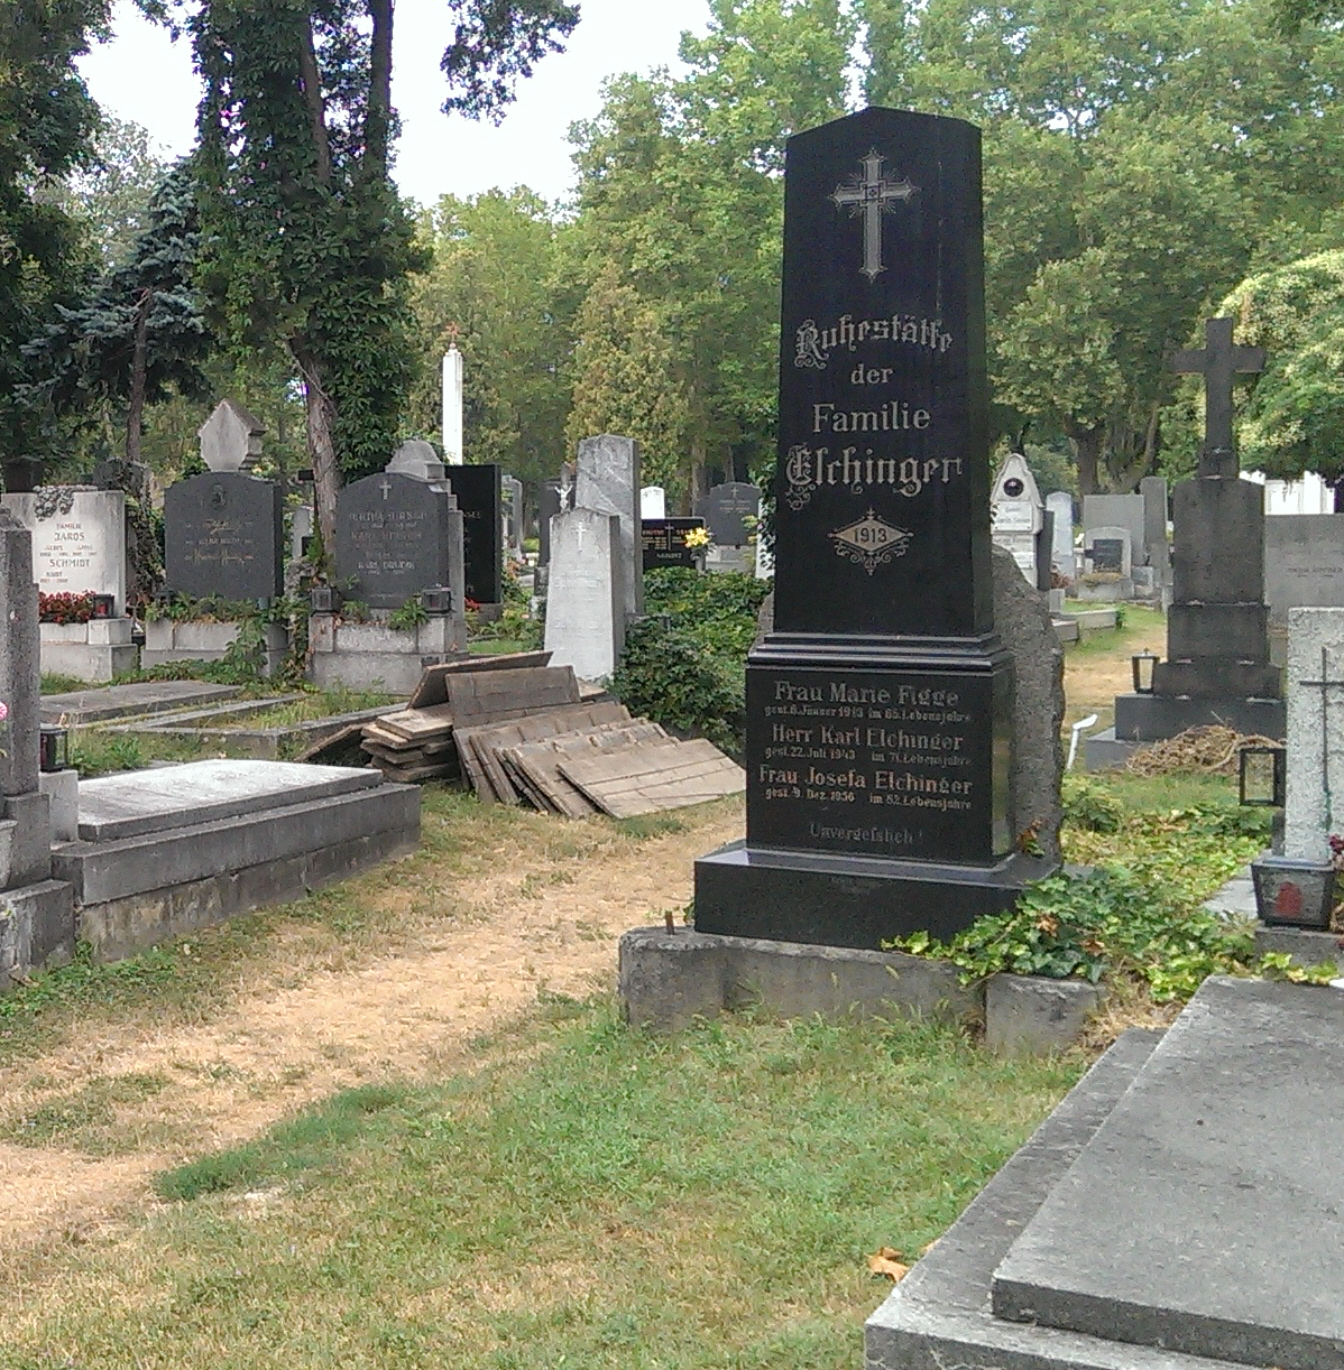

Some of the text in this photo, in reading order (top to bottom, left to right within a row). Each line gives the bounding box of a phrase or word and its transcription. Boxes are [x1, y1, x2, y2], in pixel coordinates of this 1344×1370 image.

[794, 314, 953, 370] Ruhestätte
[850, 363, 893, 385] der
[812, 400, 931, 433] Familie
[785, 442, 963, 510] Elchinger
[853, 527, 888, 544] 1913
[49, 559, 90, 568] SCHMIDT
[774, 680, 959, 707] Frau Marie Figge
[773, 722, 964, 751] Herr Karl Elchinger
[759, 763, 974, 795] Frau Josefa Elchinger
